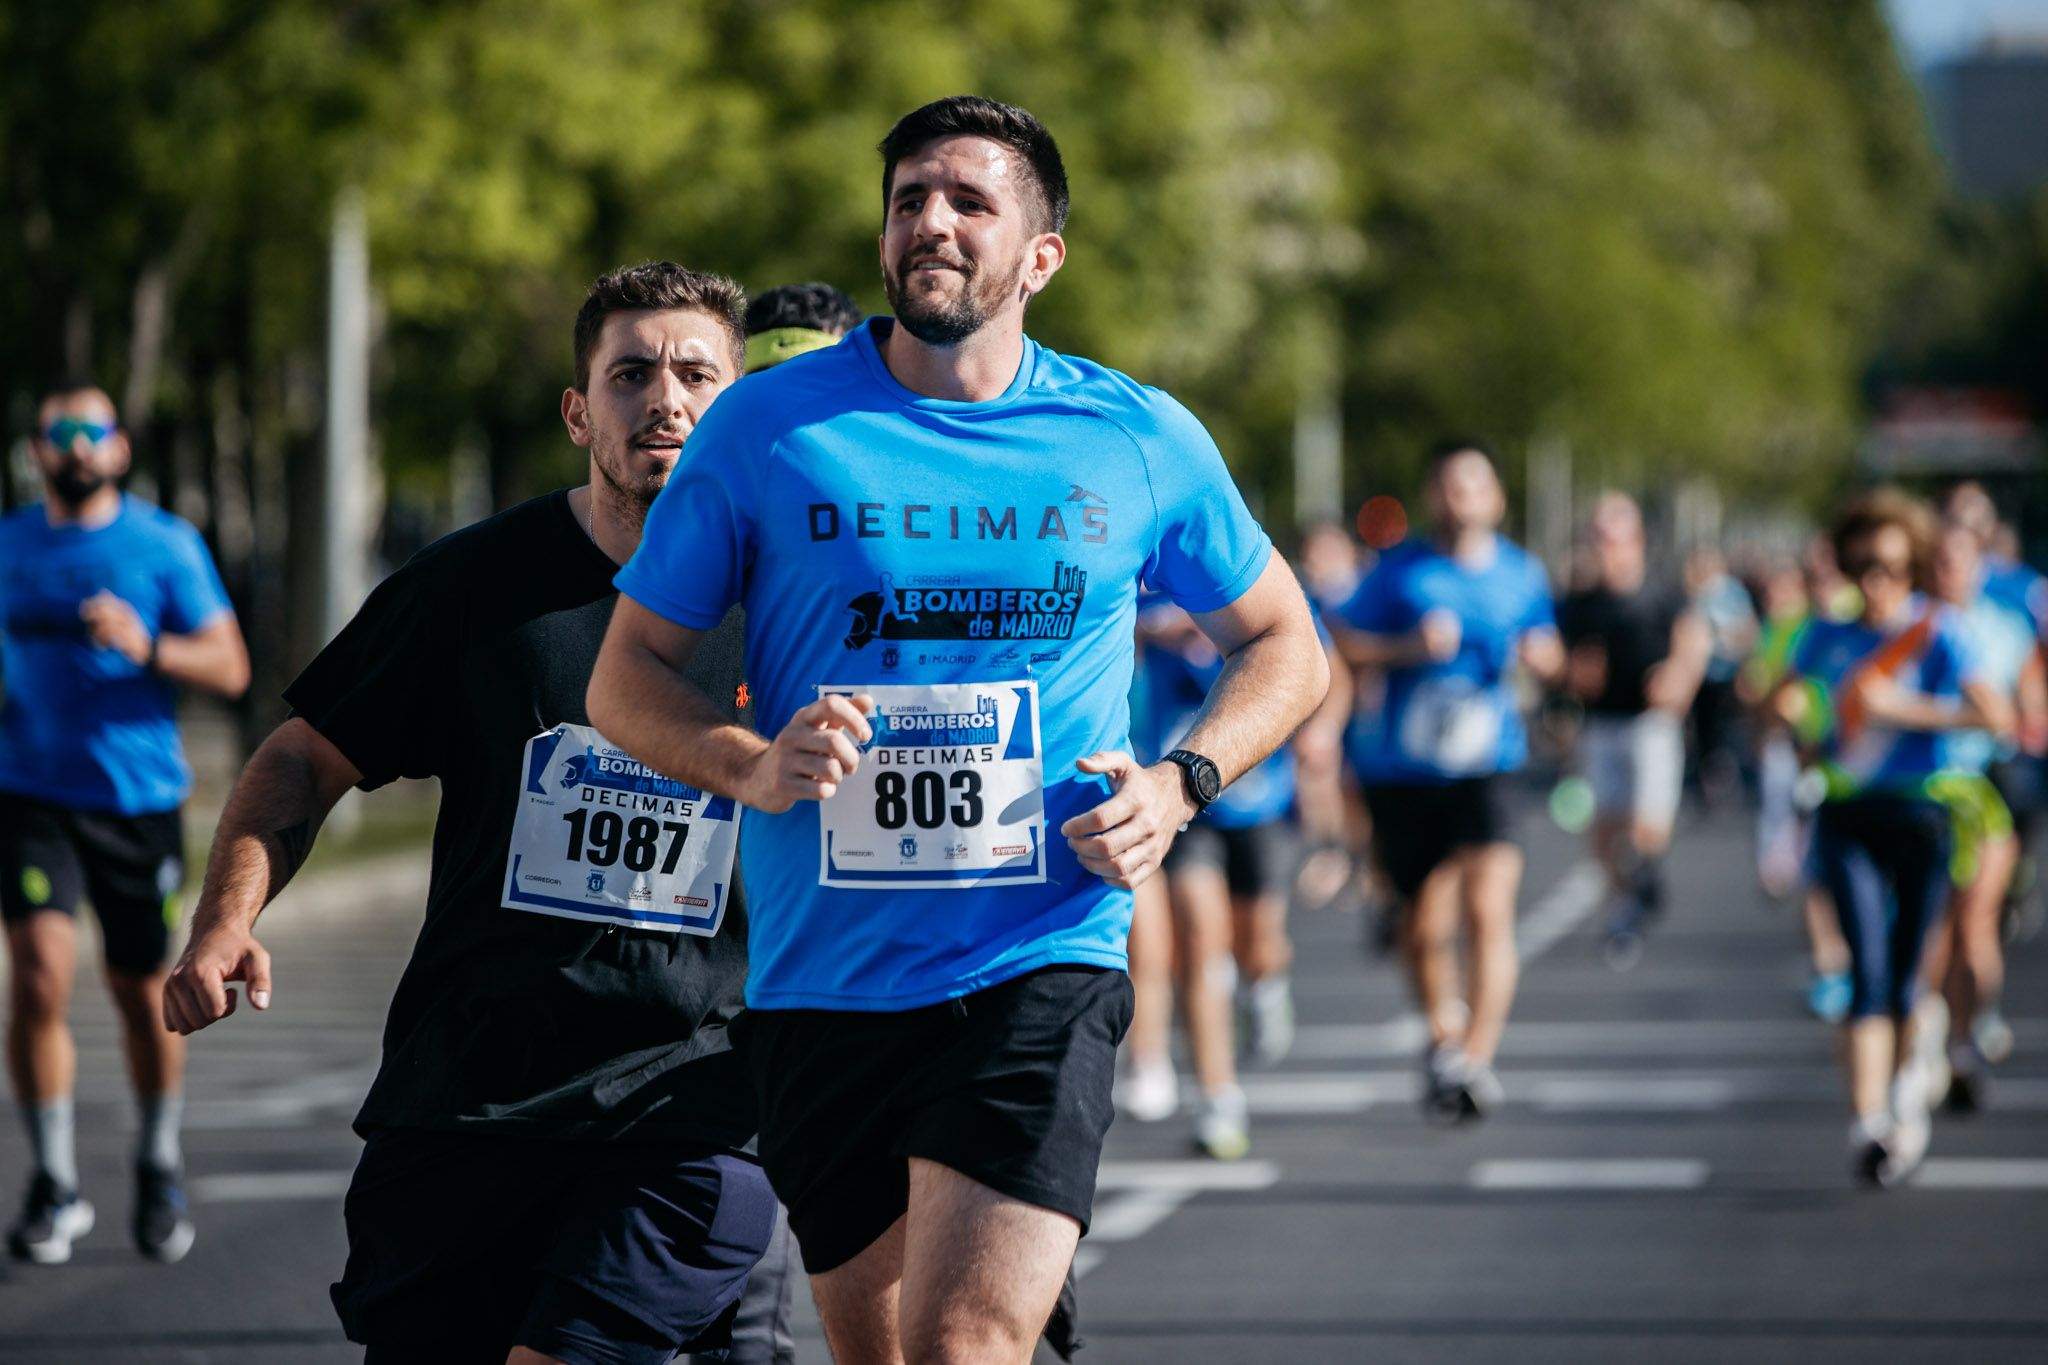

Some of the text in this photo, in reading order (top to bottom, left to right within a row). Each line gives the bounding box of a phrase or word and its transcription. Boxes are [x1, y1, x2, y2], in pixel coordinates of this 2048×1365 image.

[808, 502, 1109, 544] DECIMAS
[905, 575, 961, 586] CARRERA
[904, 590, 1078, 613] BOMBEROS
[969, 614, 1073, 638] de MADRID
[890, 705, 928, 714] CARRERA
[889, 713, 995, 730] BOMBEROS
[931, 728, 996, 745] de MADRID
[878, 747, 993, 765] DECIMAS
[635, 779, 649, 792] de
[581, 787, 694, 817] DECIMAS
[875, 770, 984, 829] 803
[563, 808, 689, 874] 1987
